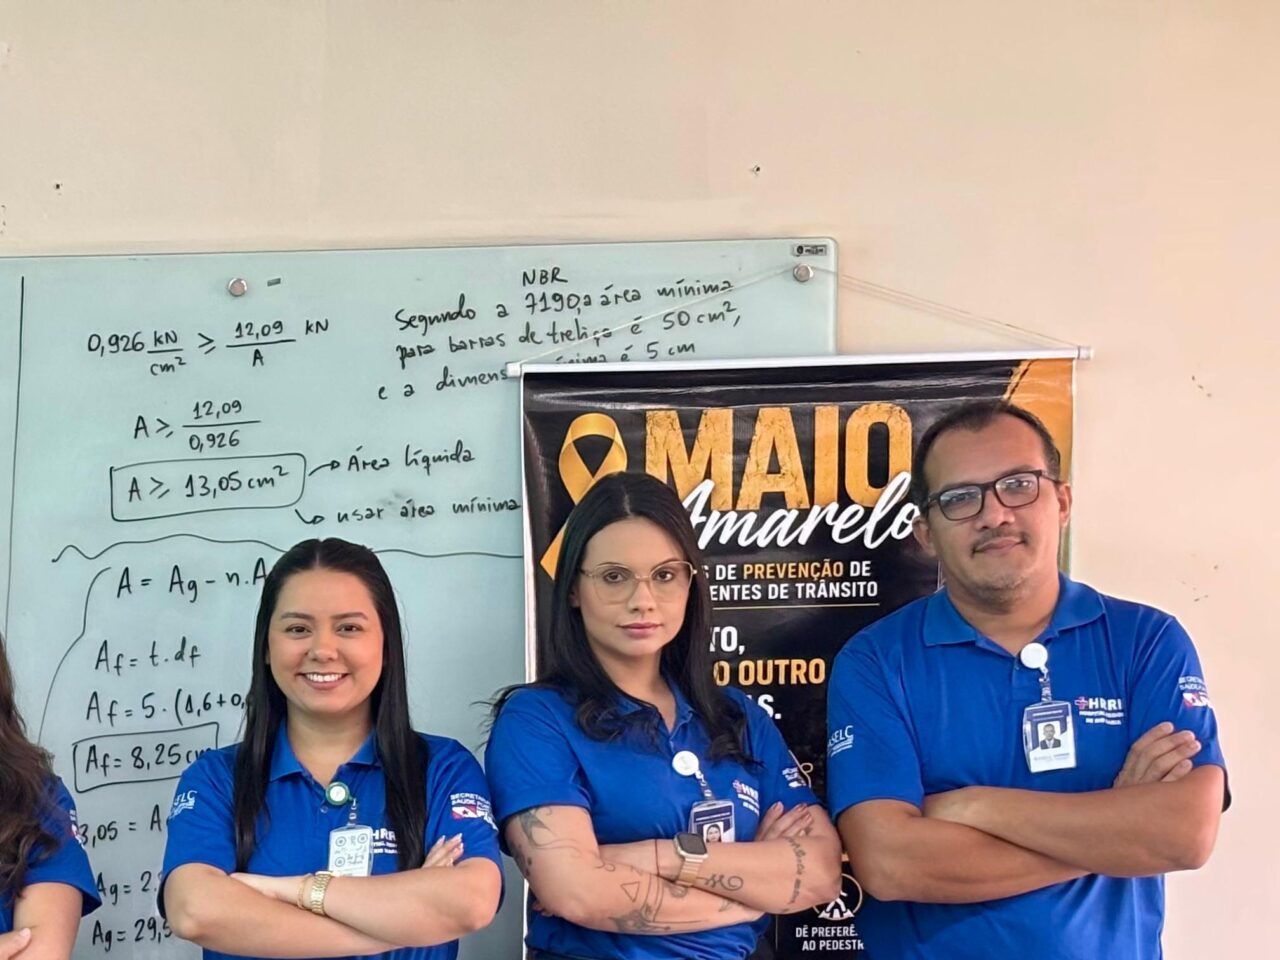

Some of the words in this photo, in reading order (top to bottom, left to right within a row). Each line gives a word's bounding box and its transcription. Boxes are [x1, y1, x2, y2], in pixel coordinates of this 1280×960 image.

[522, 267, 567, 286] NBR
[395, 293, 476, 336] Segundo
[496, 304, 510, 318] a
[599, 285, 642, 304] área
[657, 278, 733, 299] mínima
[153, 328, 178, 347] kN
[234, 319, 284, 343] 12,09
[305, 318, 330, 335] kN
[87, 331, 145, 356] 0,926
[395, 343, 435, 369] para
[449, 332, 505, 353] barras
[519, 325, 542, 345] de
[252, 347, 265, 368] A
[436, 366, 508, 390] dimens
[647, 341, 659, 359] 5
[669, 342, 696, 356] cm
[193, 399, 243, 421] 12,09
[134, 416, 150, 440] A
[189, 429, 240, 453] 0,926
[348, 446, 390, 473] Área
[645, 401, 912, 511] MAIO
[128, 477, 142, 502] A
[337, 506, 384, 524] usar
[400, 499, 435, 519] área
[453, 496, 520, 516] mínima
[716, 564, 737, 580] DE
[743, 558, 844, 581] PREVENÇÃO
[850, 561, 871, 577] DE
[117, 566, 132, 598] A
[710, 584, 762, 601] ENTES
[768, 583, 789, 599] DE
[795, 579, 878, 599] TRÂNSITO
[738, 658, 826, 686] OUTRO
[134, 918, 172, 944] 29,5
[796, 924, 809, 938] DÊ
[802, 940, 816, 951] AO
